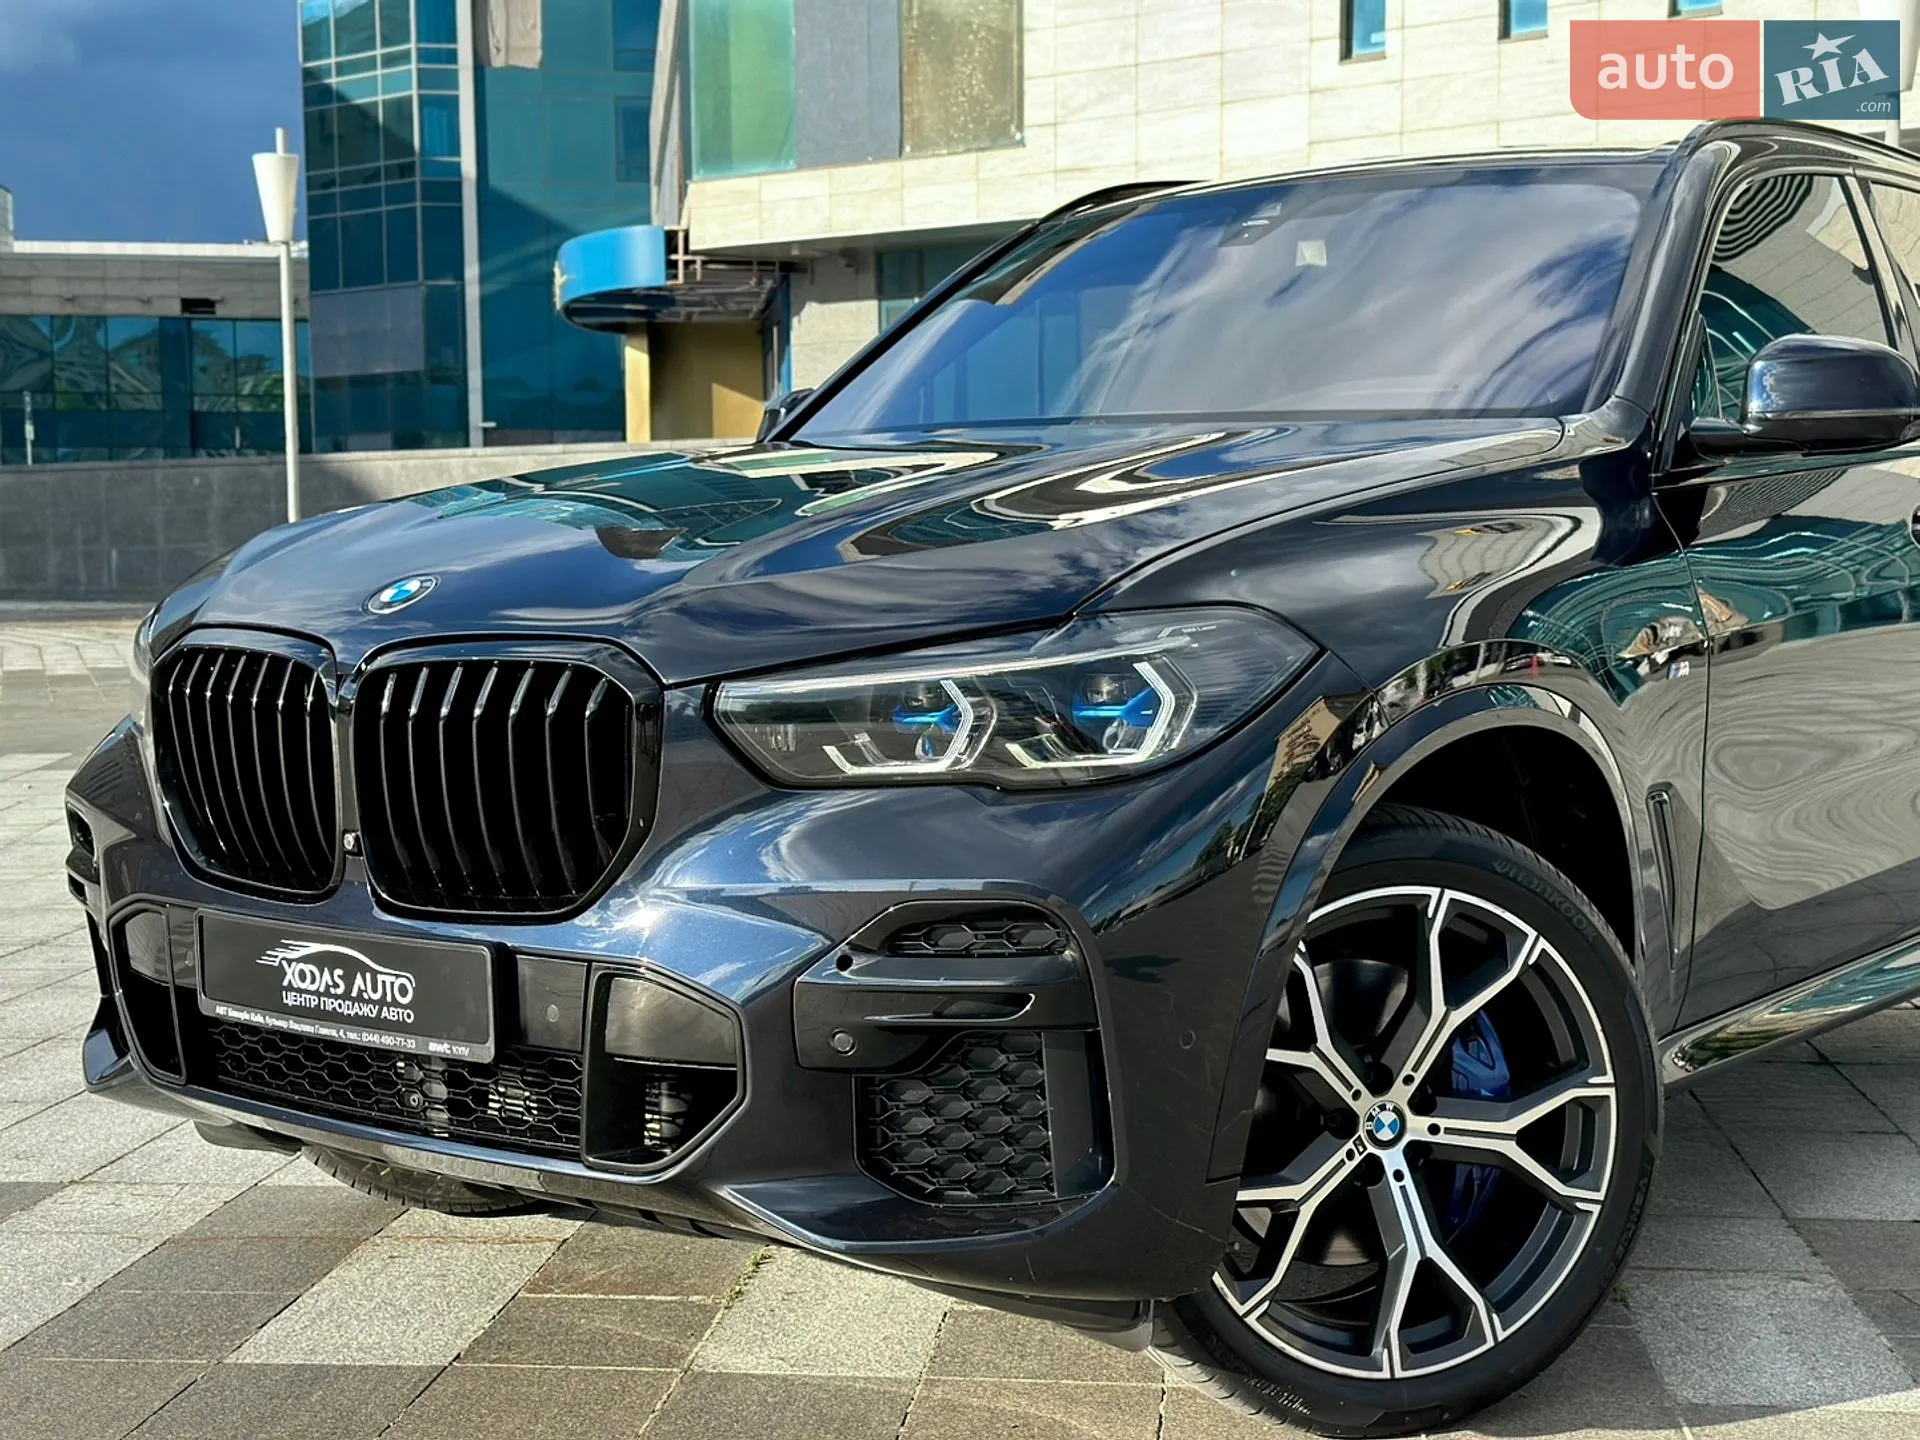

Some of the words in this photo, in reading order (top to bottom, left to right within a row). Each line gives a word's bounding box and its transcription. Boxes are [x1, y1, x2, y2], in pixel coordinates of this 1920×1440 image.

[351, 971, 413, 1005] AUTO
[282, 990, 319, 1007] ЦЕНТР
[320, 997, 379, 1017] ПРОДАЖУ
[380, 1006, 415, 1024] АВТО
[381, 1035, 416, 1049] 490-77-33
